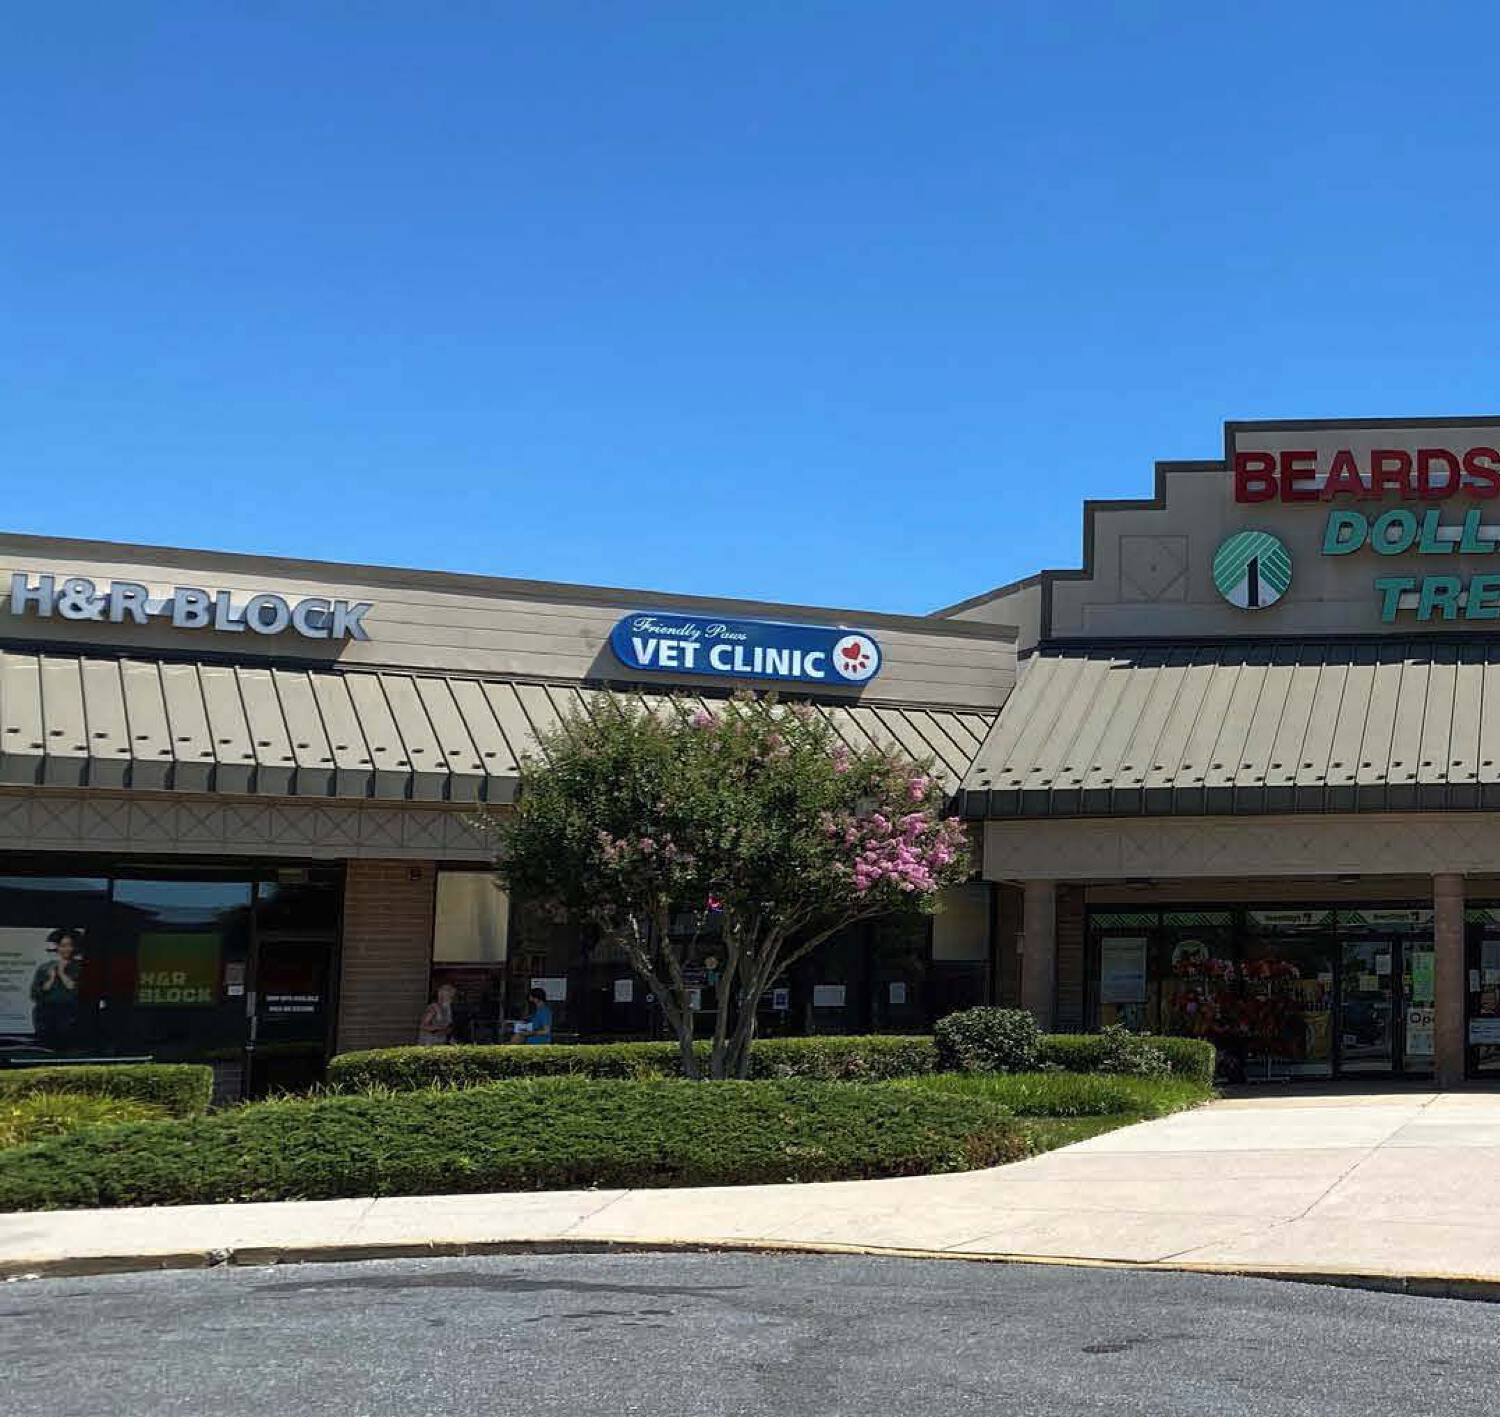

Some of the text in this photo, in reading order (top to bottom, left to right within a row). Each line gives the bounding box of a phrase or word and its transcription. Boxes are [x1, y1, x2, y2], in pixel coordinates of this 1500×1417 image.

[9, 572, 371, 642] H&R BLOCK
[633, 617, 748, 642] Friendly Paws
[631, 637, 826, 678] VET CLINIC
[138, 987, 212, 1003] BLOCK
